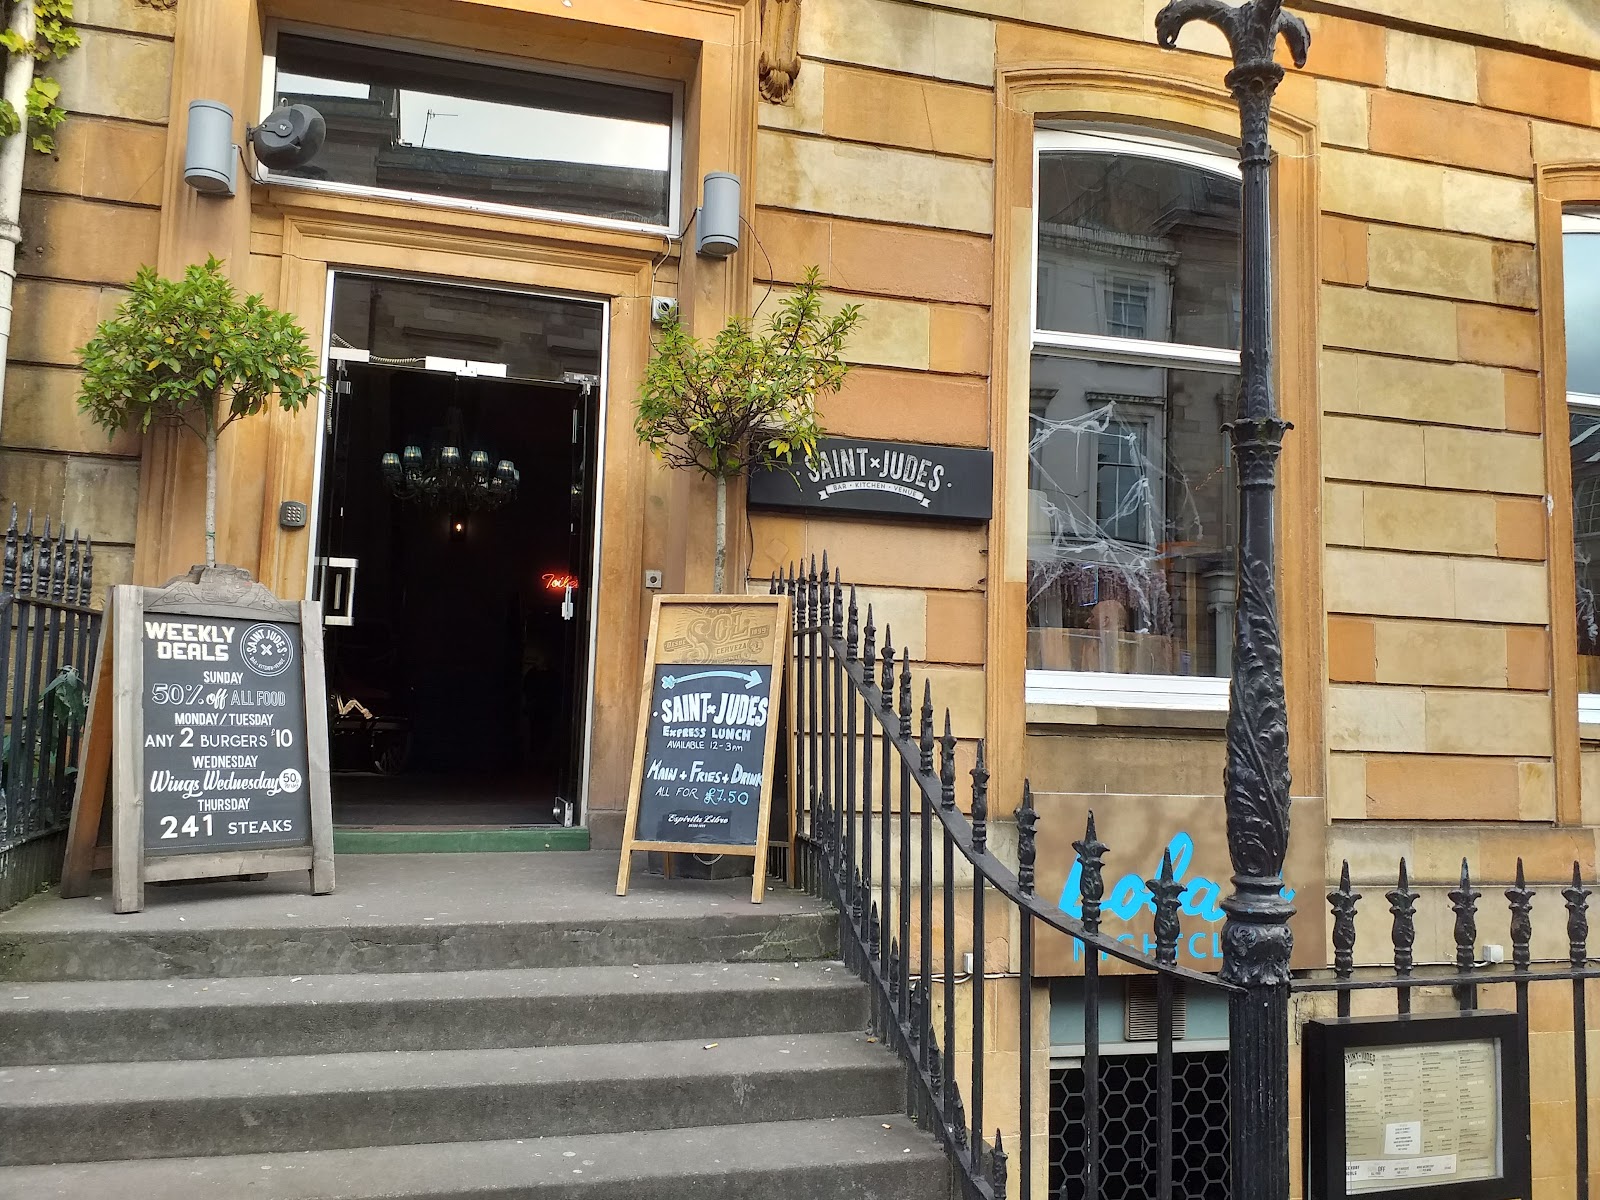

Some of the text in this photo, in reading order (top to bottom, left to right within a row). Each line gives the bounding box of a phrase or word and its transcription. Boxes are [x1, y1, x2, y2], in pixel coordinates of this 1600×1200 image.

[804, 448, 945, 492] SAINT JUDES
[833, 481, 917, 498] BAR KITCHEN VENUE
[145, 622, 235, 643] WEEKLY
[246, 629, 288, 654] SAINT JUDES
[686, 613, 750, 664] SOL
[157, 641, 229, 661] DEALS
[716, 643, 747, 654] CERVEZA
[204, 671, 244, 684] SUNDAY
[152, 683, 286, 710] 50% off ALL FOOD
[661, 692, 768, 727] SAINT JUDES
[145, 727, 293, 748] ANY 2 BURGERS £10
[711, 728, 751, 742] LUNCH
[667, 741, 705, 750] AVAILABLE
[192, 755, 258, 768] WEDNESDAY
[647, 759, 678, 781] MAIN
[680, 771, 687, 780] +
[689, 760, 722, 783] FRIES
[150, 770, 203, 799] Wings
[203, 770, 282, 796] Wednesday
[198, 798, 250, 811] THURSDAY
[655, 786, 749, 806] ALL FOR £7.50
[160, 814, 292, 839] 241 STEAKS
[704, 815, 728, 824] Libre
